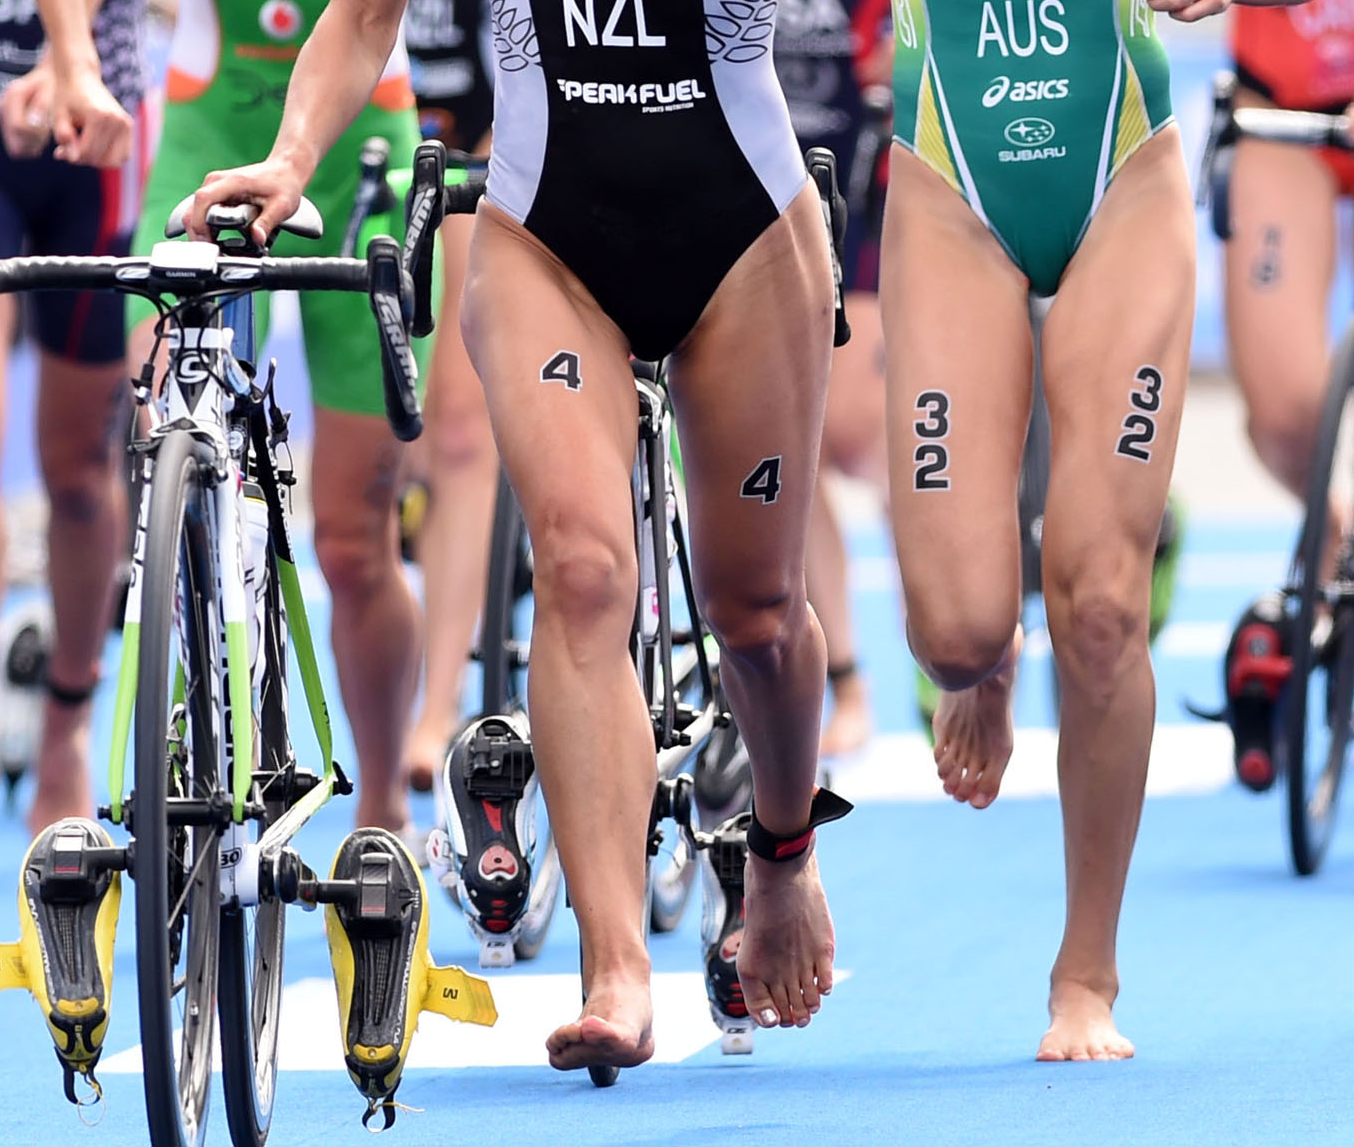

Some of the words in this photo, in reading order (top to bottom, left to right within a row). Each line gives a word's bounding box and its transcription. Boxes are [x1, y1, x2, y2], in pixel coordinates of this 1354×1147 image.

[998, 146, 1066, 163] SUBARU
[538, 350, 583, 393] 4
[1115, 364, 1163, 464] 32
[913, 391, 952, 493] 32
[739, 455, 783, 506] 4
